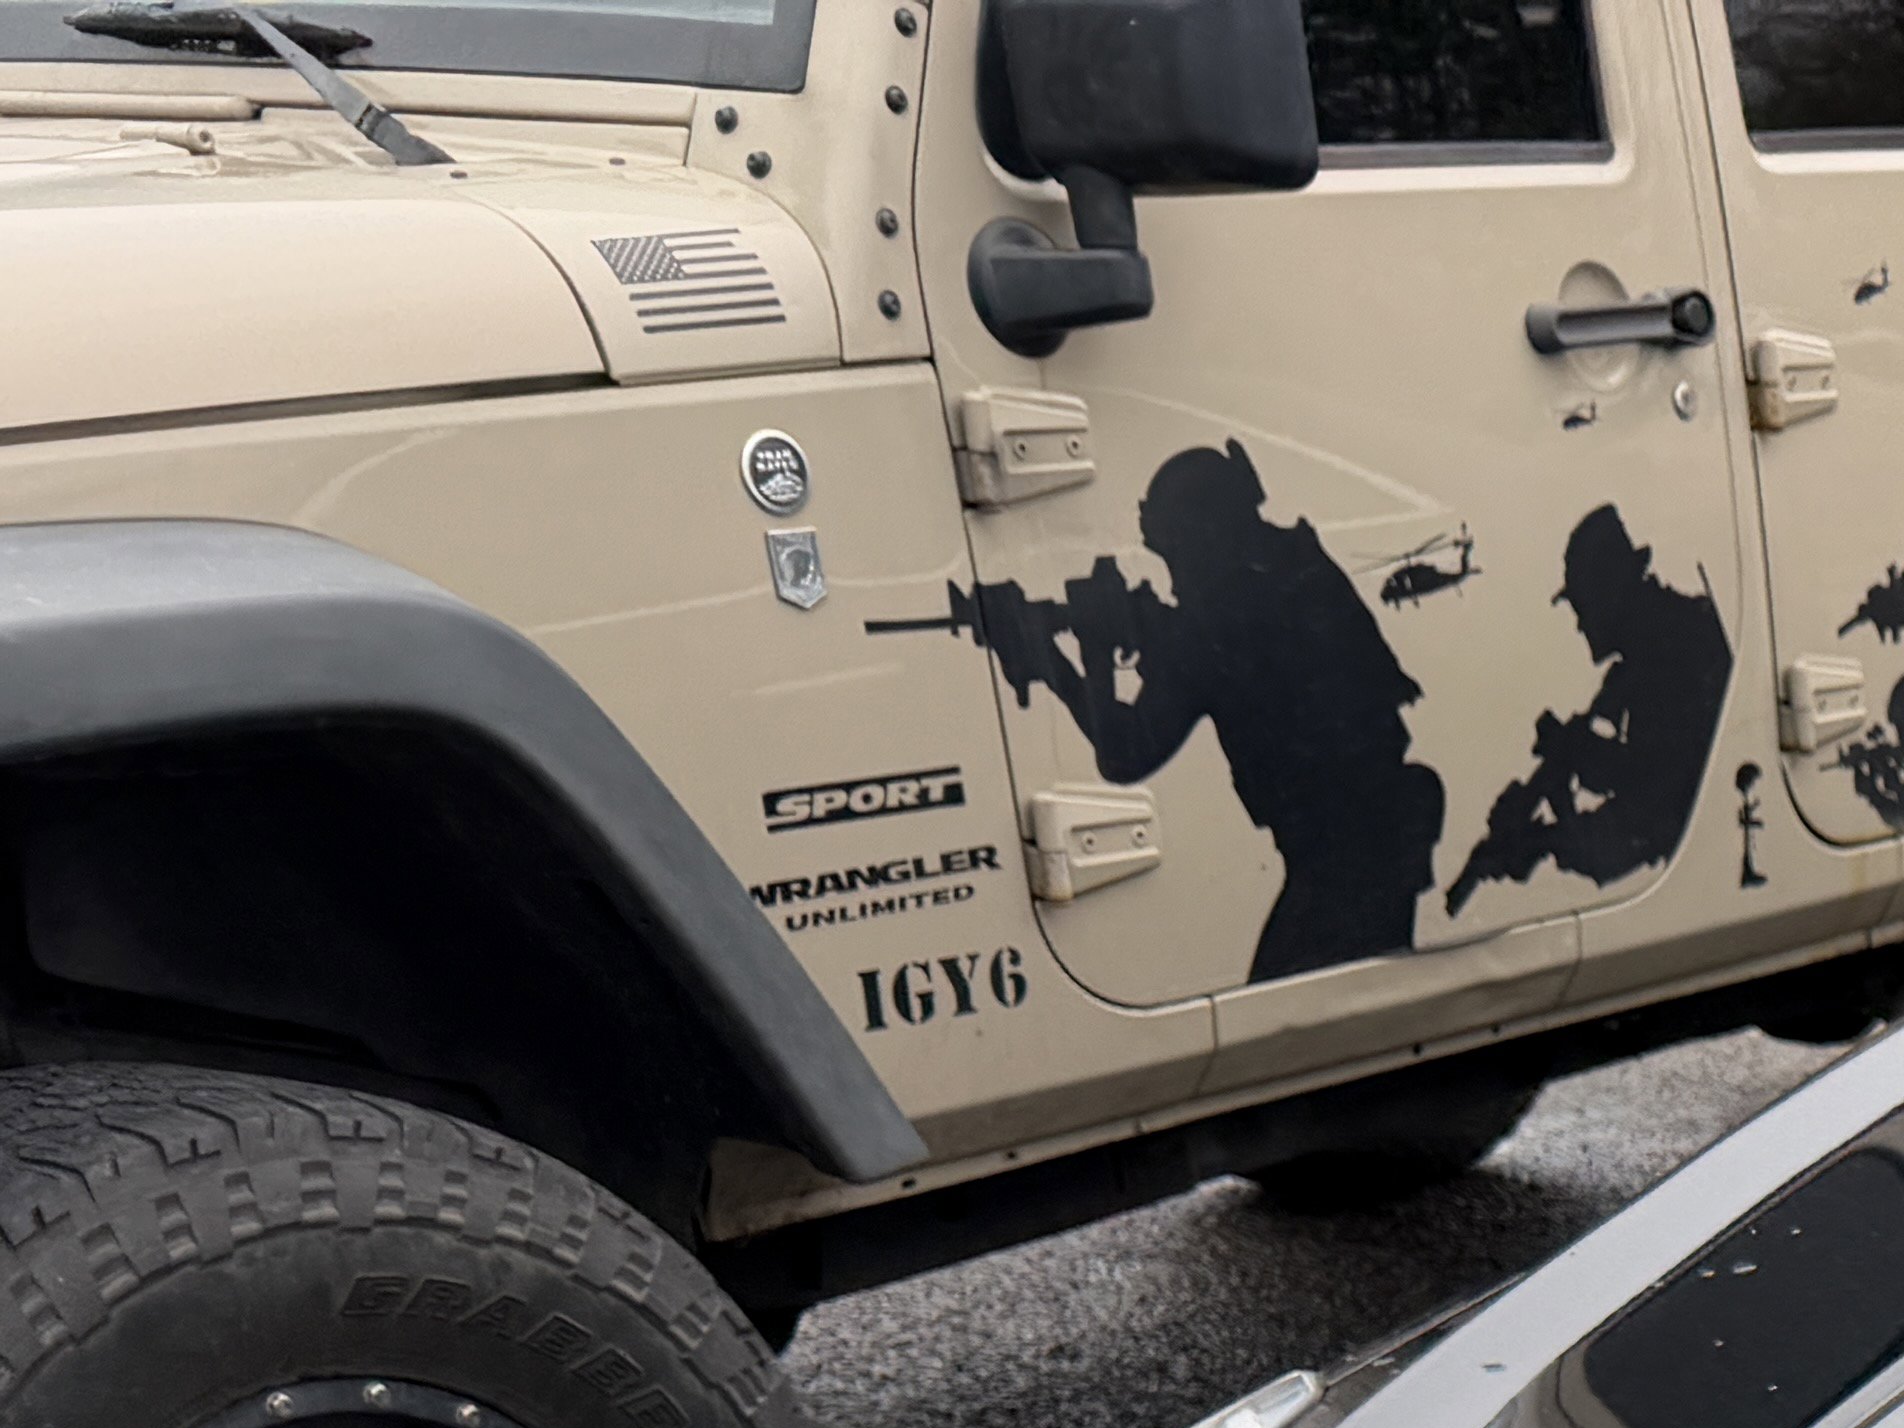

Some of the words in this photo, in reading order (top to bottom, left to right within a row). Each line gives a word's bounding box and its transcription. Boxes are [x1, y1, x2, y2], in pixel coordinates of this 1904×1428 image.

[770, 774, 963, 826] SPORT
[749, 845, 1001, 908] WRANGLER
[785, 883, 976, 932] UNLIMITED
[856, 946, 1028, 1033] IGY6
